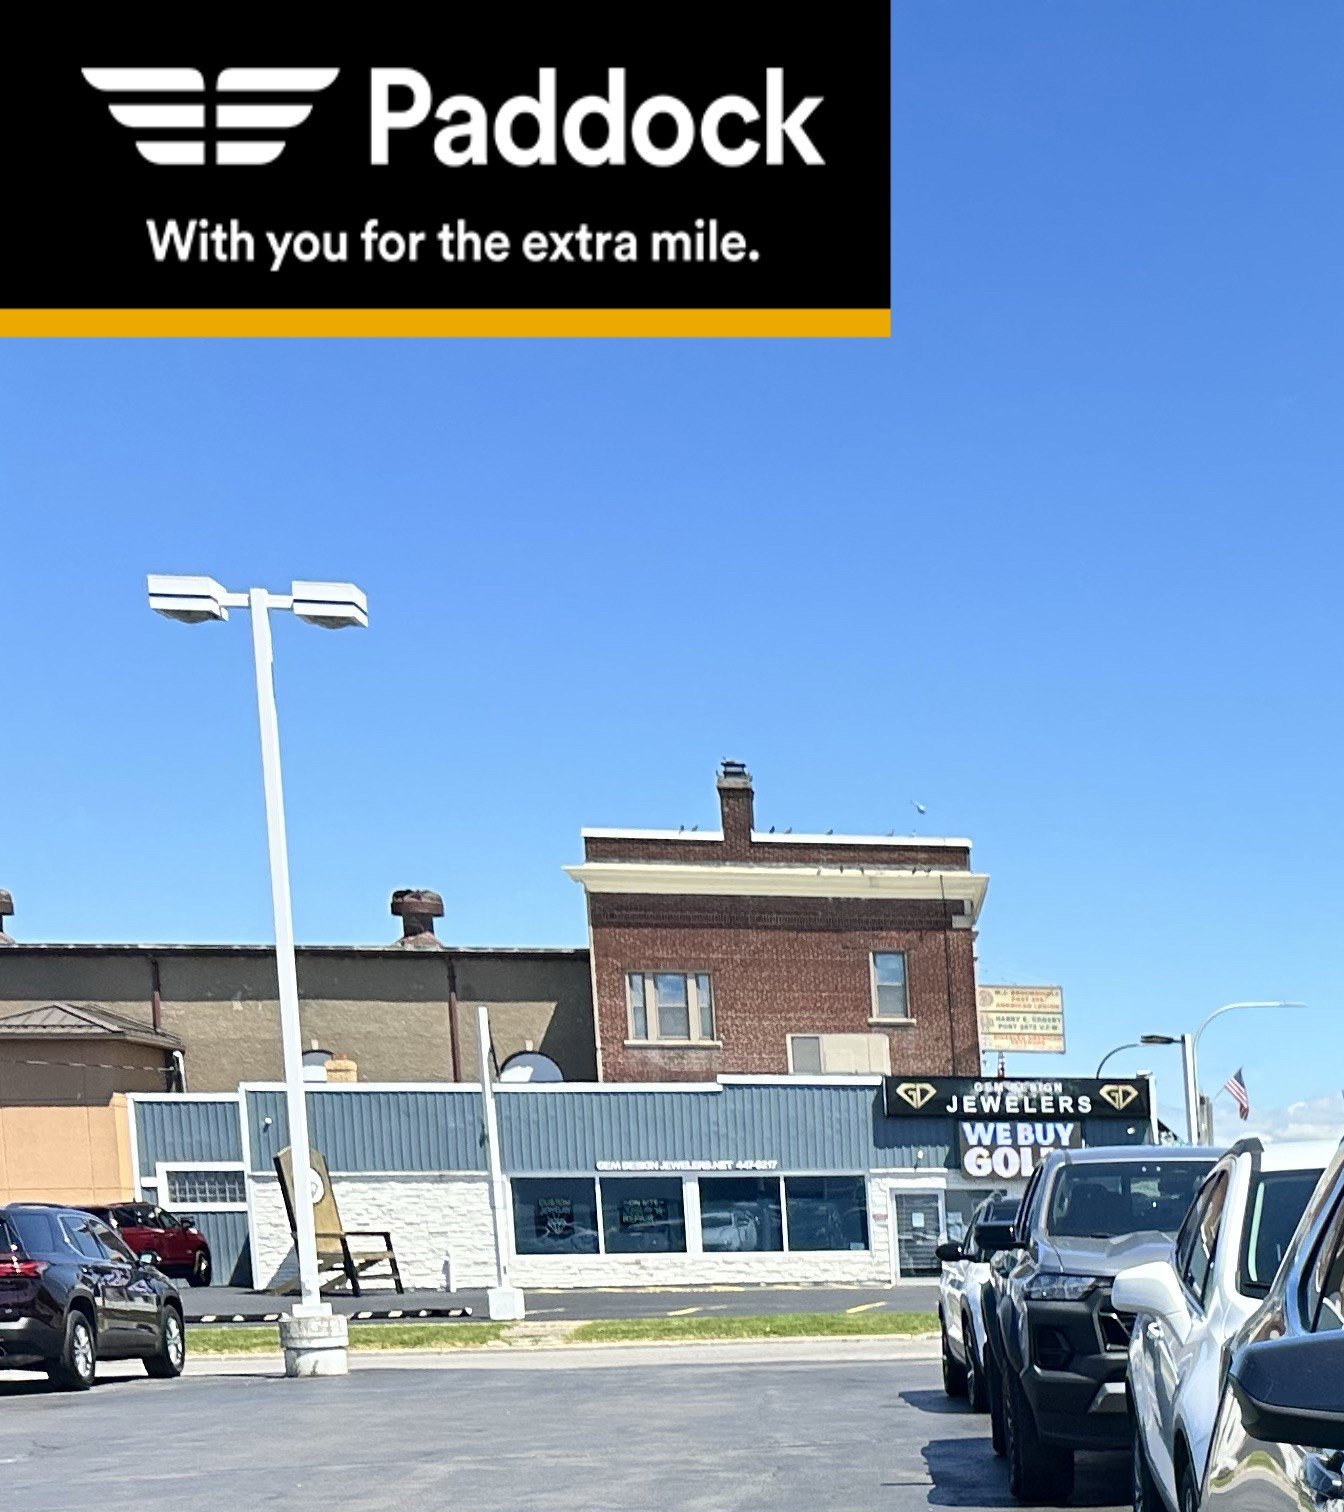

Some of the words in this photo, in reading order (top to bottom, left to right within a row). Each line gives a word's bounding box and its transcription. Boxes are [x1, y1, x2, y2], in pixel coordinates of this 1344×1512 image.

[946, 1095, 1092, 1114] JEWELERS
[962, 1121, 1013, 1146] WE
[1017, 1122, 1074, 1147] BUY
